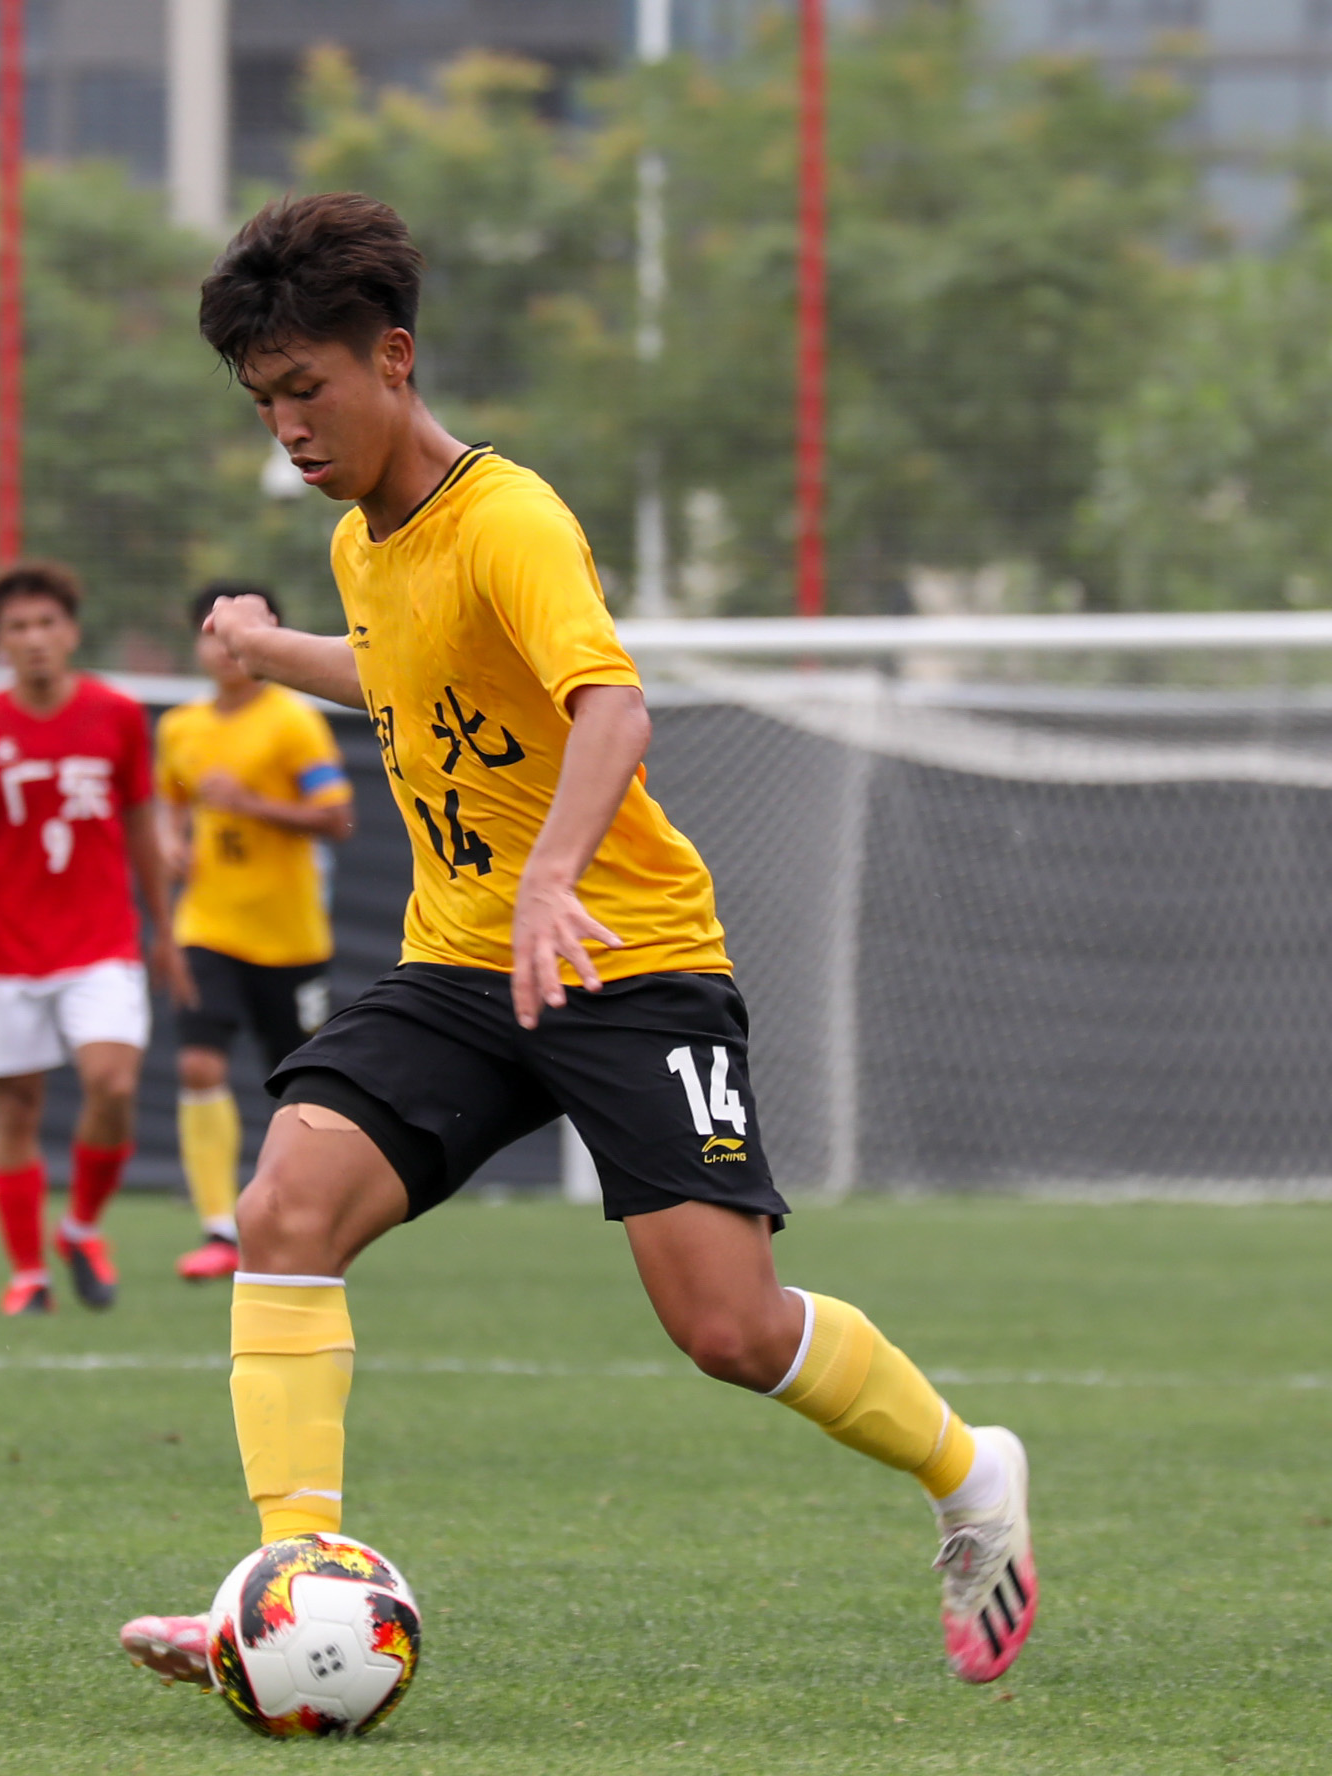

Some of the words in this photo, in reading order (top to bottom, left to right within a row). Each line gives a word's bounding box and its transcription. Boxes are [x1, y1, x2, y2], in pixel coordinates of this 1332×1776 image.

[0, 756, 113, 826] 广东
[41, 817, 74, 874] 9
[415, 789, 494, 881] 14
[665, 1045, 747, 1136] 14
[704, 1152, 747, 1164] LI-NING
